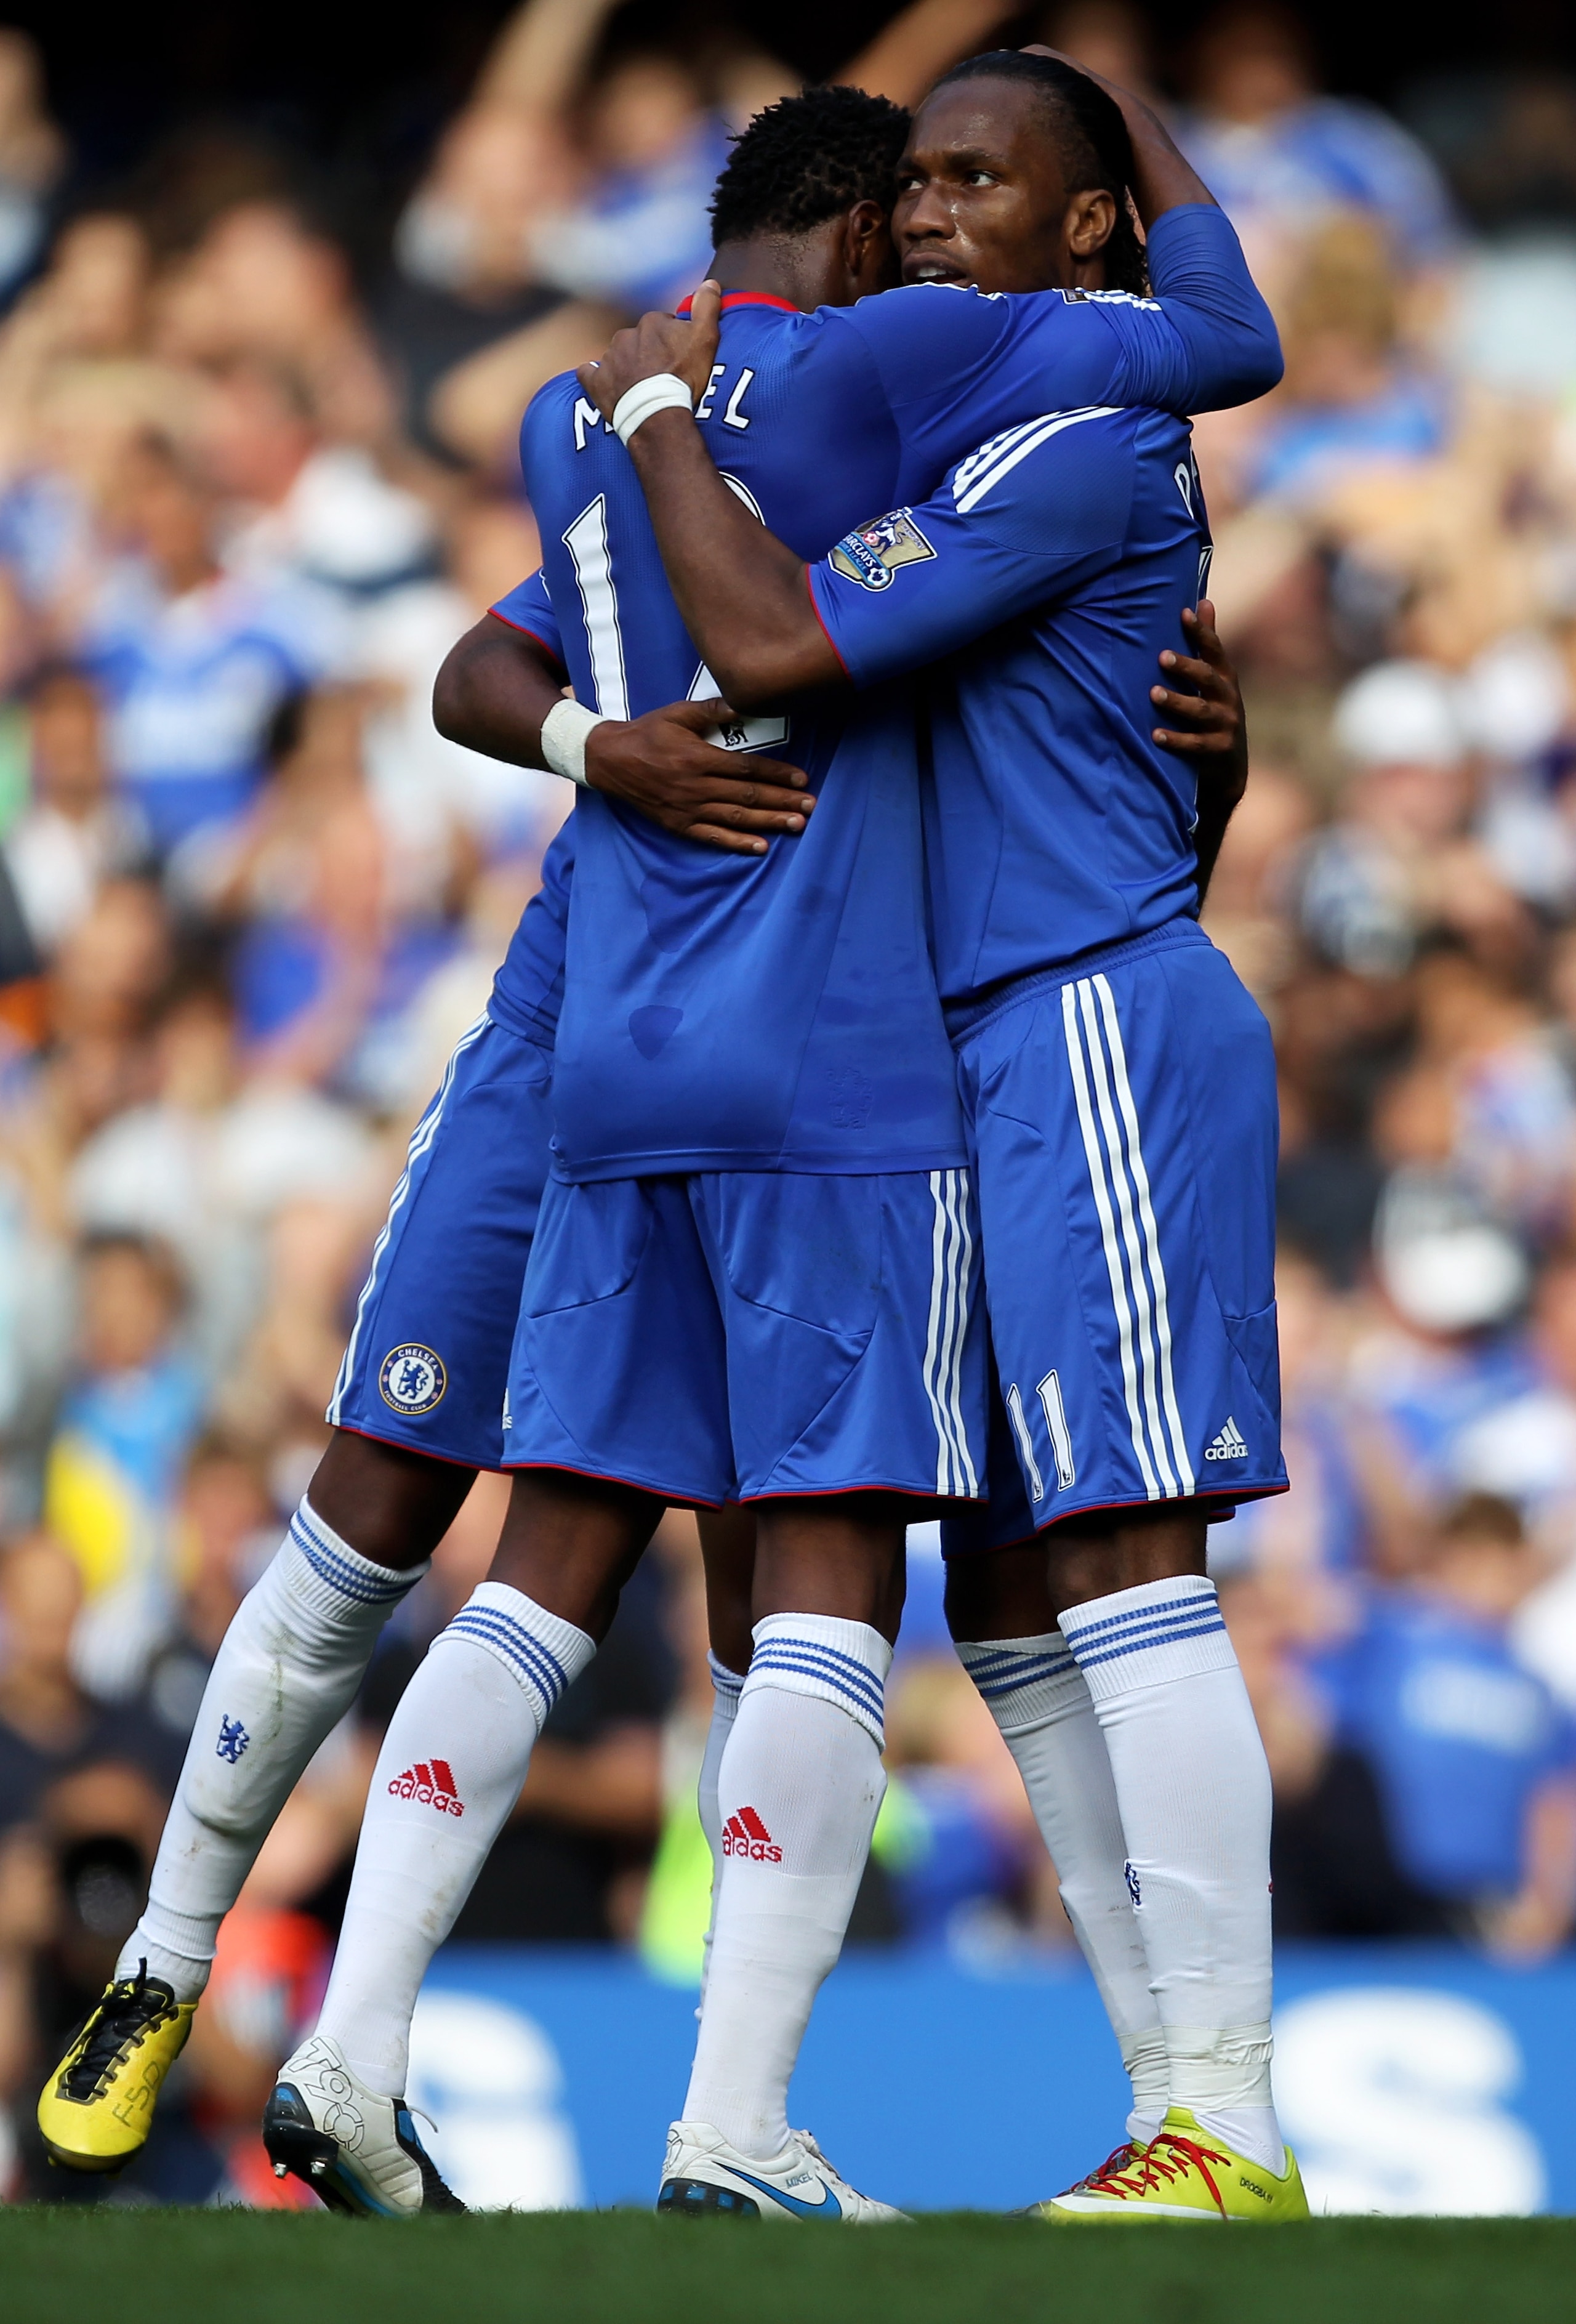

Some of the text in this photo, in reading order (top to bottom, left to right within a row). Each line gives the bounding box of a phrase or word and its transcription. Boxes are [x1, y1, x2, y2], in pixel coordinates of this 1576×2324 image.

[574, 363, 755, 451] MEL
[397, 1348, 439, 1370] CHELSEA
[384, 1390, 427, 1411] FOOTBALL CLUB
[1006, 1368, 1075, 1504] 11
[388, 1780, 465, 1818] adidas
[722, 1836, 783, 1863] didas
[786, 2172, 813, 2189] MIKEL
[1239, 2177, 1266, 2201] DROGBA
